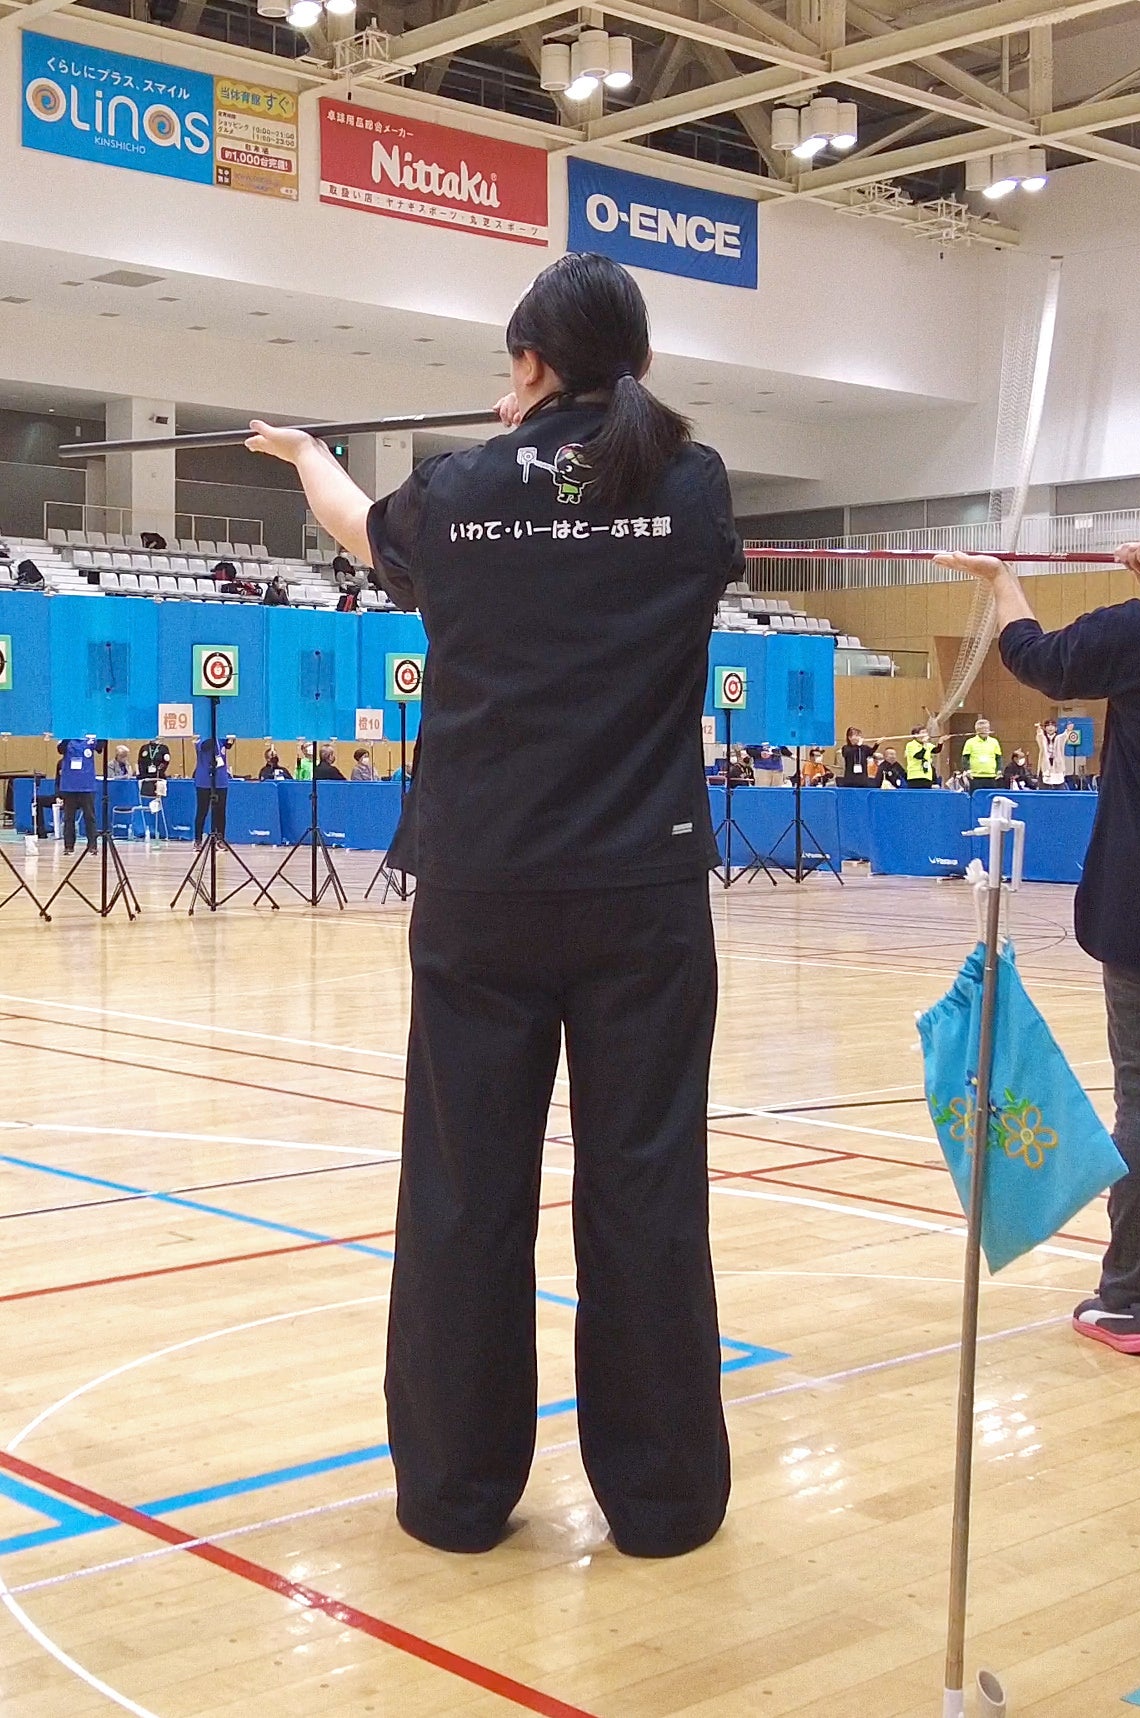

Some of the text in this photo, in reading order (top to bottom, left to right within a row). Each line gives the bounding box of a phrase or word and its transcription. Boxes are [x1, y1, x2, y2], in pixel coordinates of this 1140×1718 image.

[94, 136, 146, 154] KINSHICHO
[371, 140, 500, 208] Nittaku
[586, 193, 742, 258] O-ENCE
